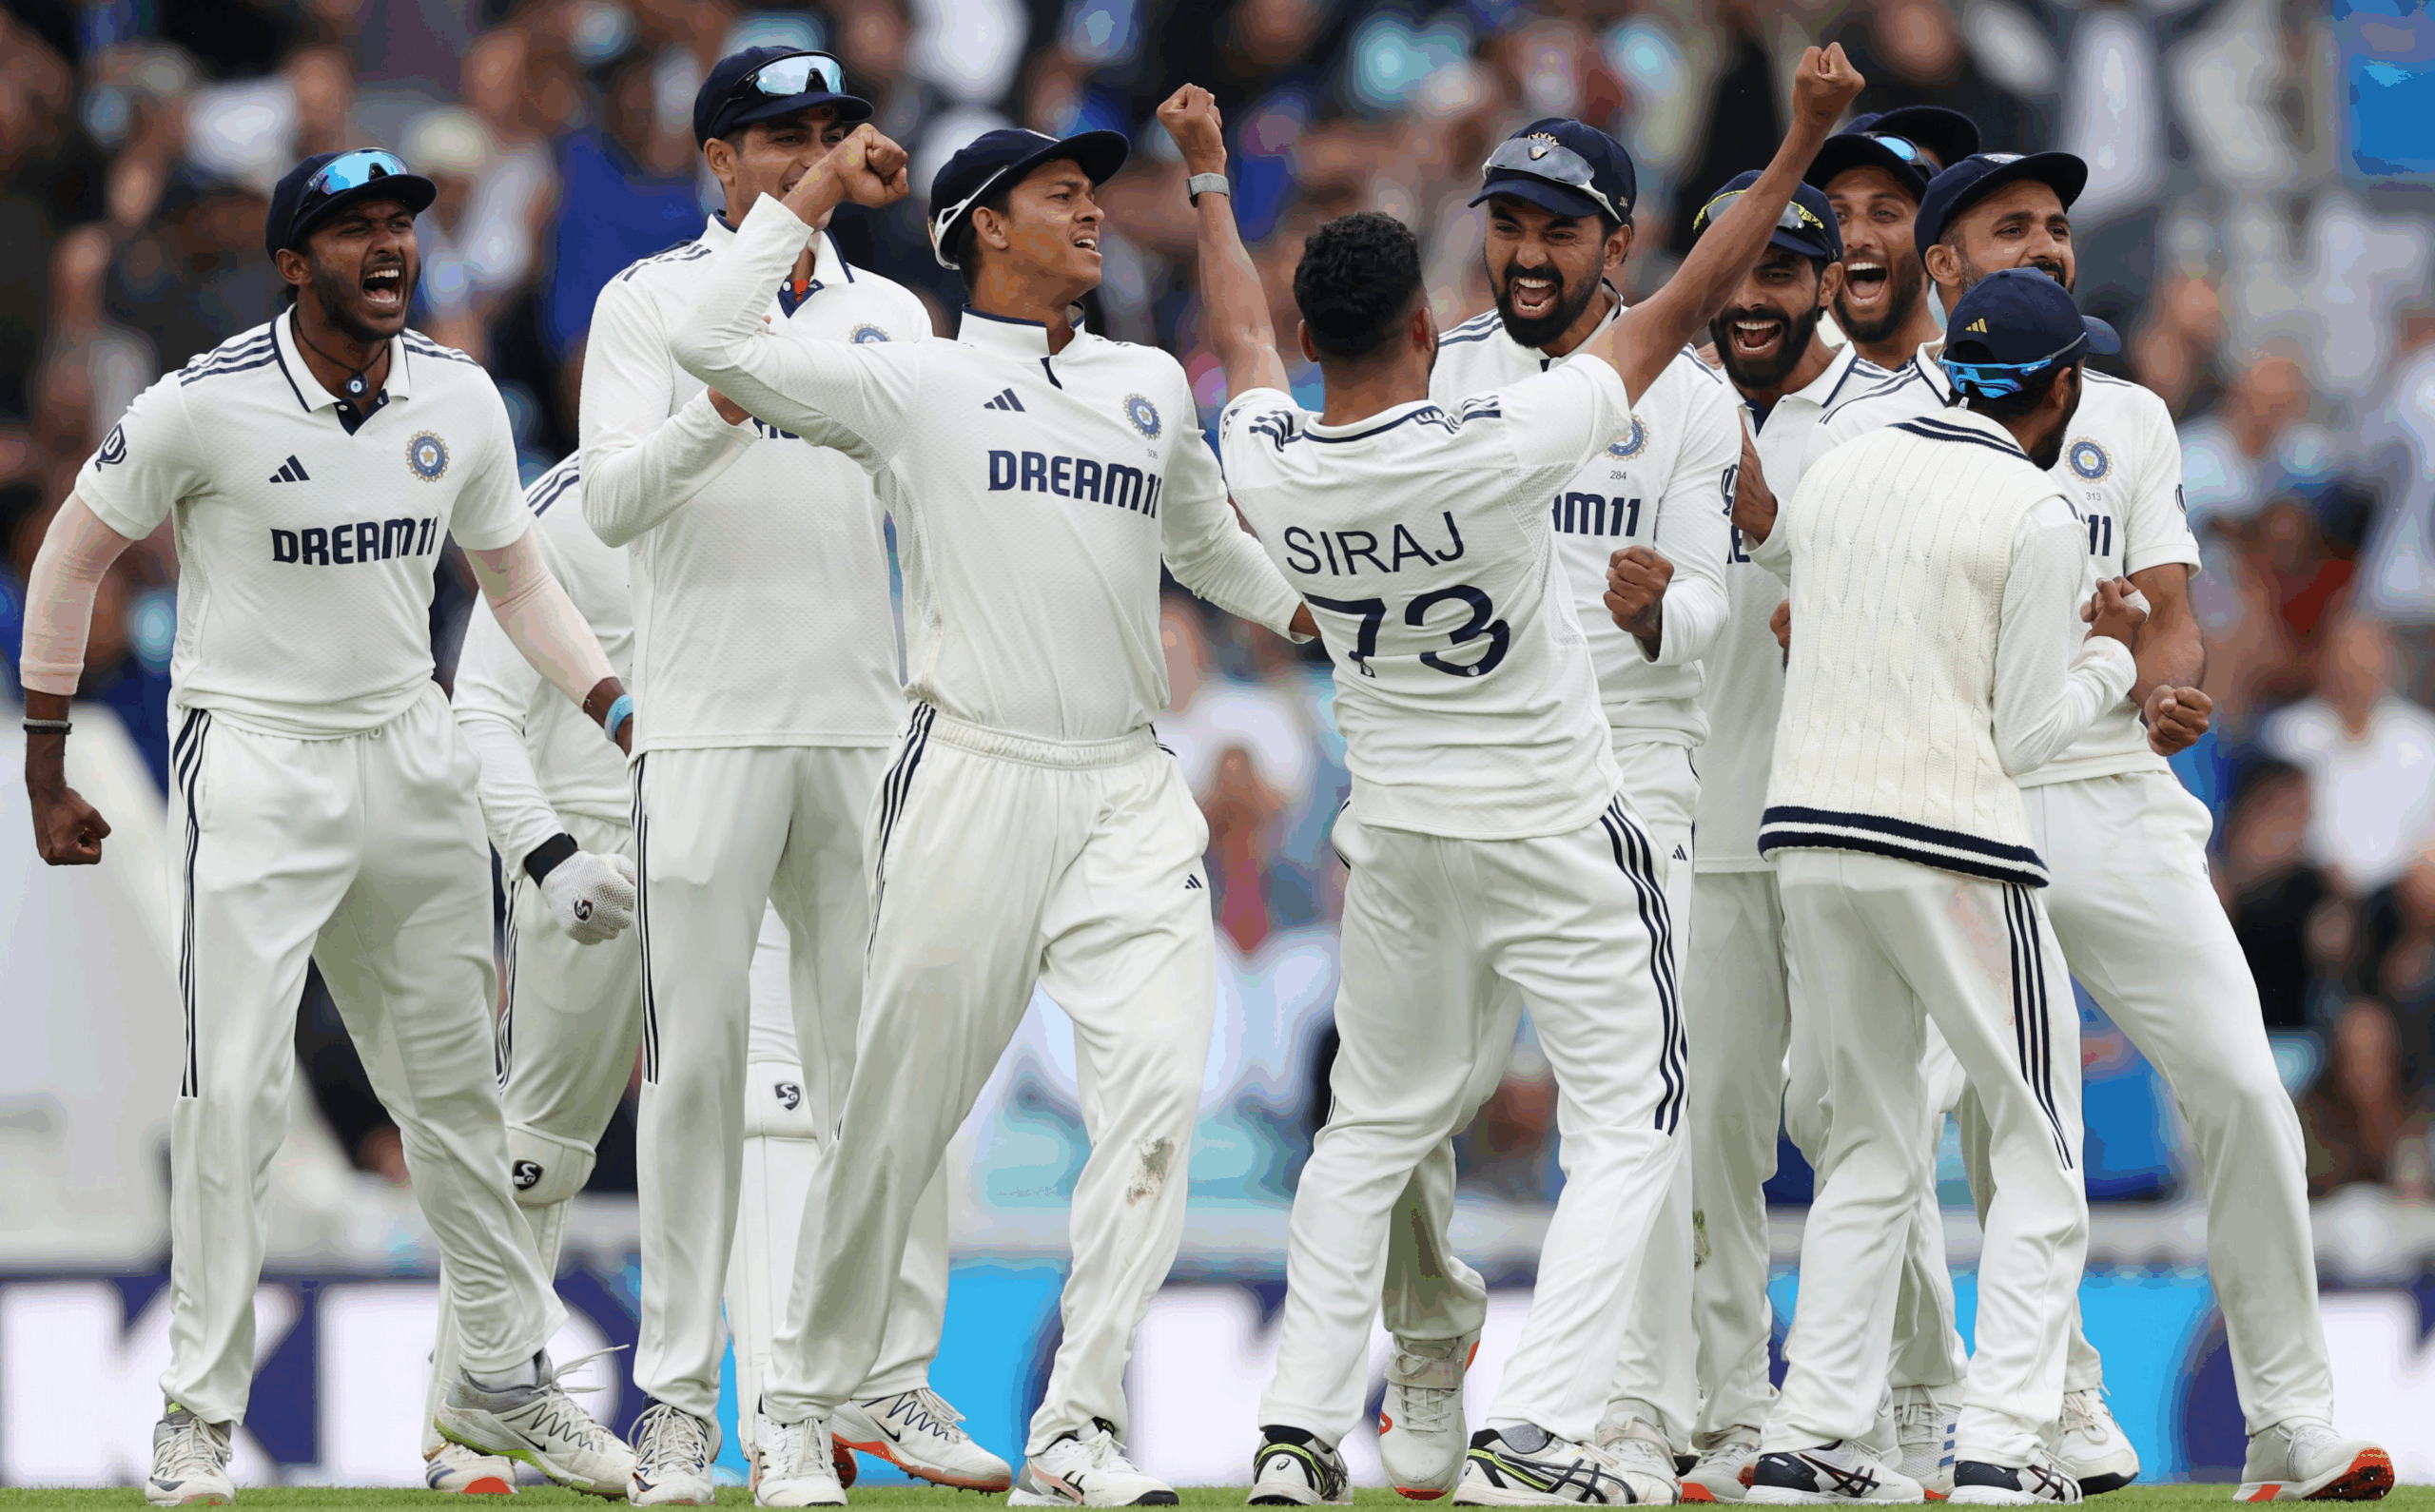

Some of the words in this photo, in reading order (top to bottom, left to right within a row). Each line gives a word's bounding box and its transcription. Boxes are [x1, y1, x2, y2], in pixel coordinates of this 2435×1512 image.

[987, 450, 1162, 519] DREAM11
[1609, 470, 1627, 480] 284
[2086, 492, 2102, 501] 313
[270, 516, 438, 566] DREAM11
[1284, 510, 1465, 576] SIRAJ
[1300, 584, 1510, 679] 73
